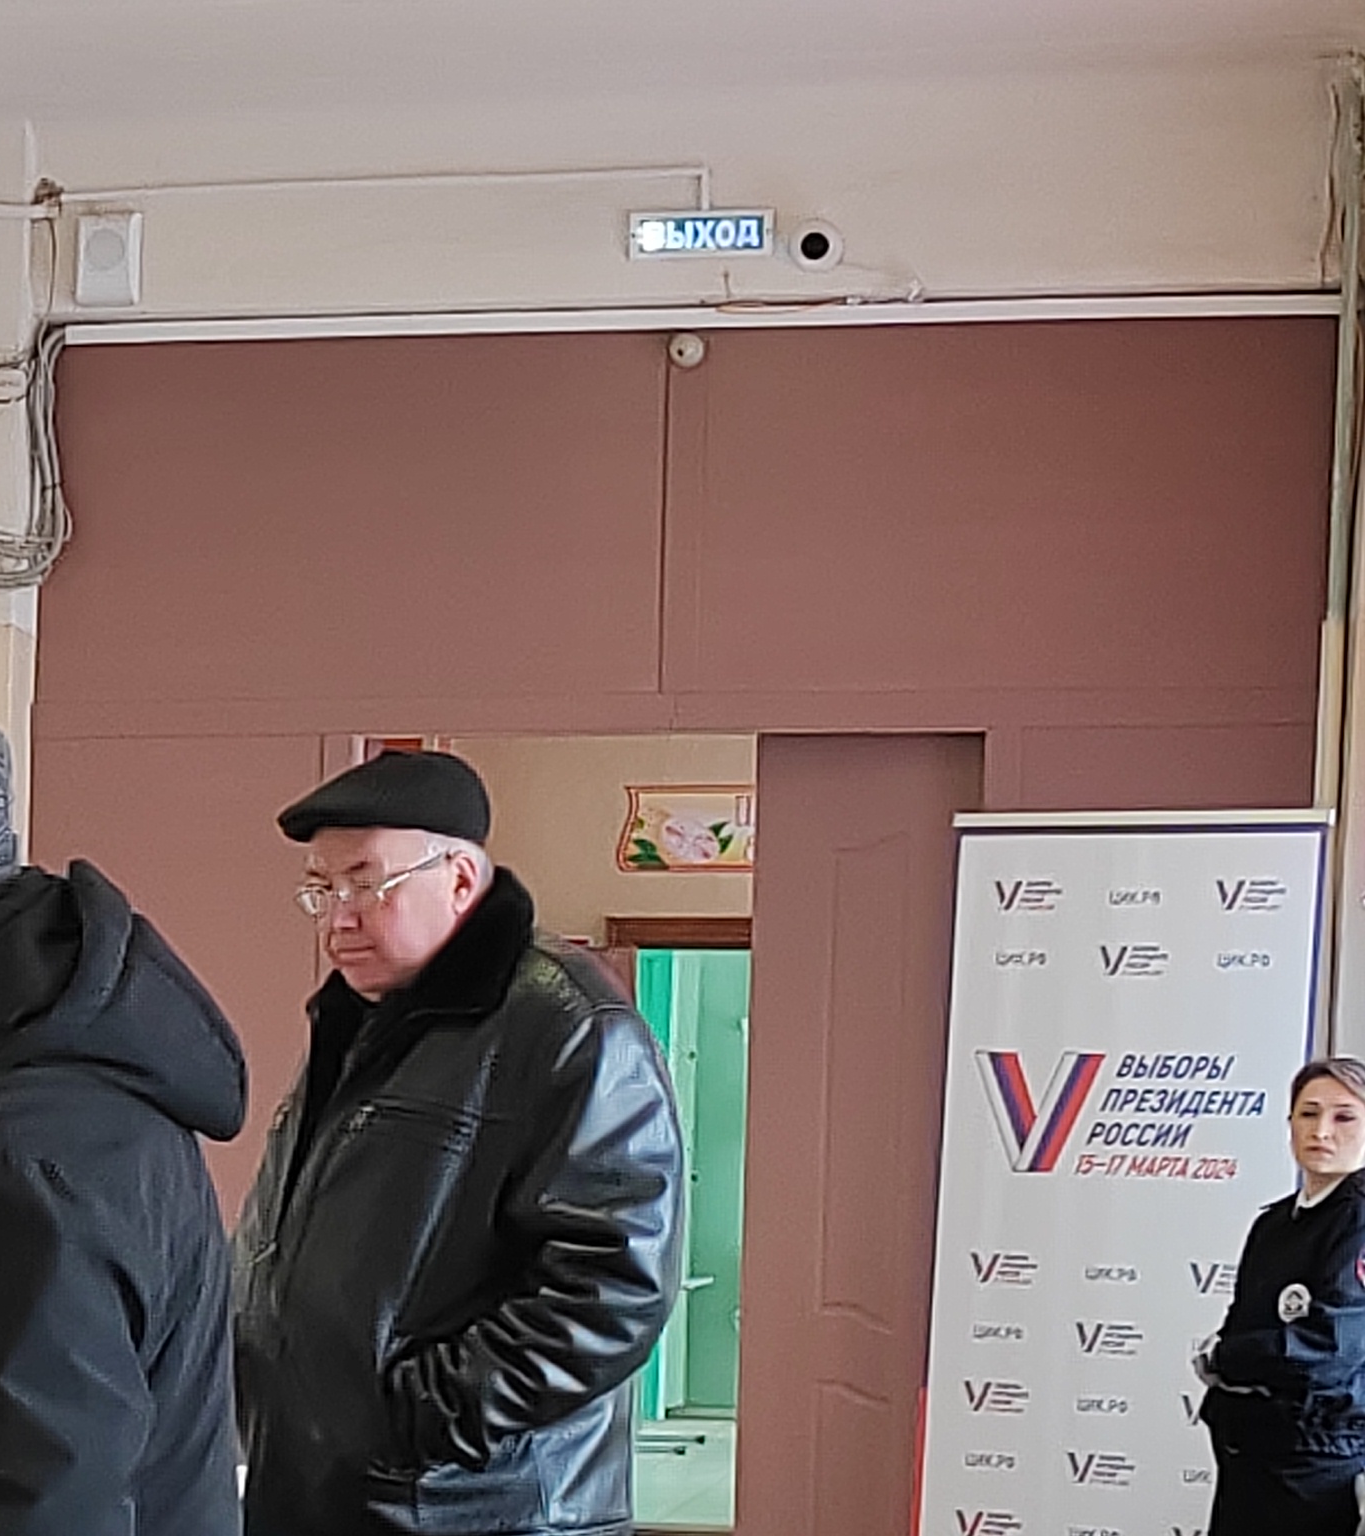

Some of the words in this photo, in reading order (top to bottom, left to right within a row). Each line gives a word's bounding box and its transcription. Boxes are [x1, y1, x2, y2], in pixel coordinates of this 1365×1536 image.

[1115, 1054, 1235, 1081] ВЫБОРЫ
[1099, 1088, 1266, 1120] ПРЕЗИДЕНТА
[1085, 1123, 1192, 1149] РОССИИ
[1126, 1157, 1190, 1179] МАРТА
[1191, 1158, 1238, 1181] 2024
